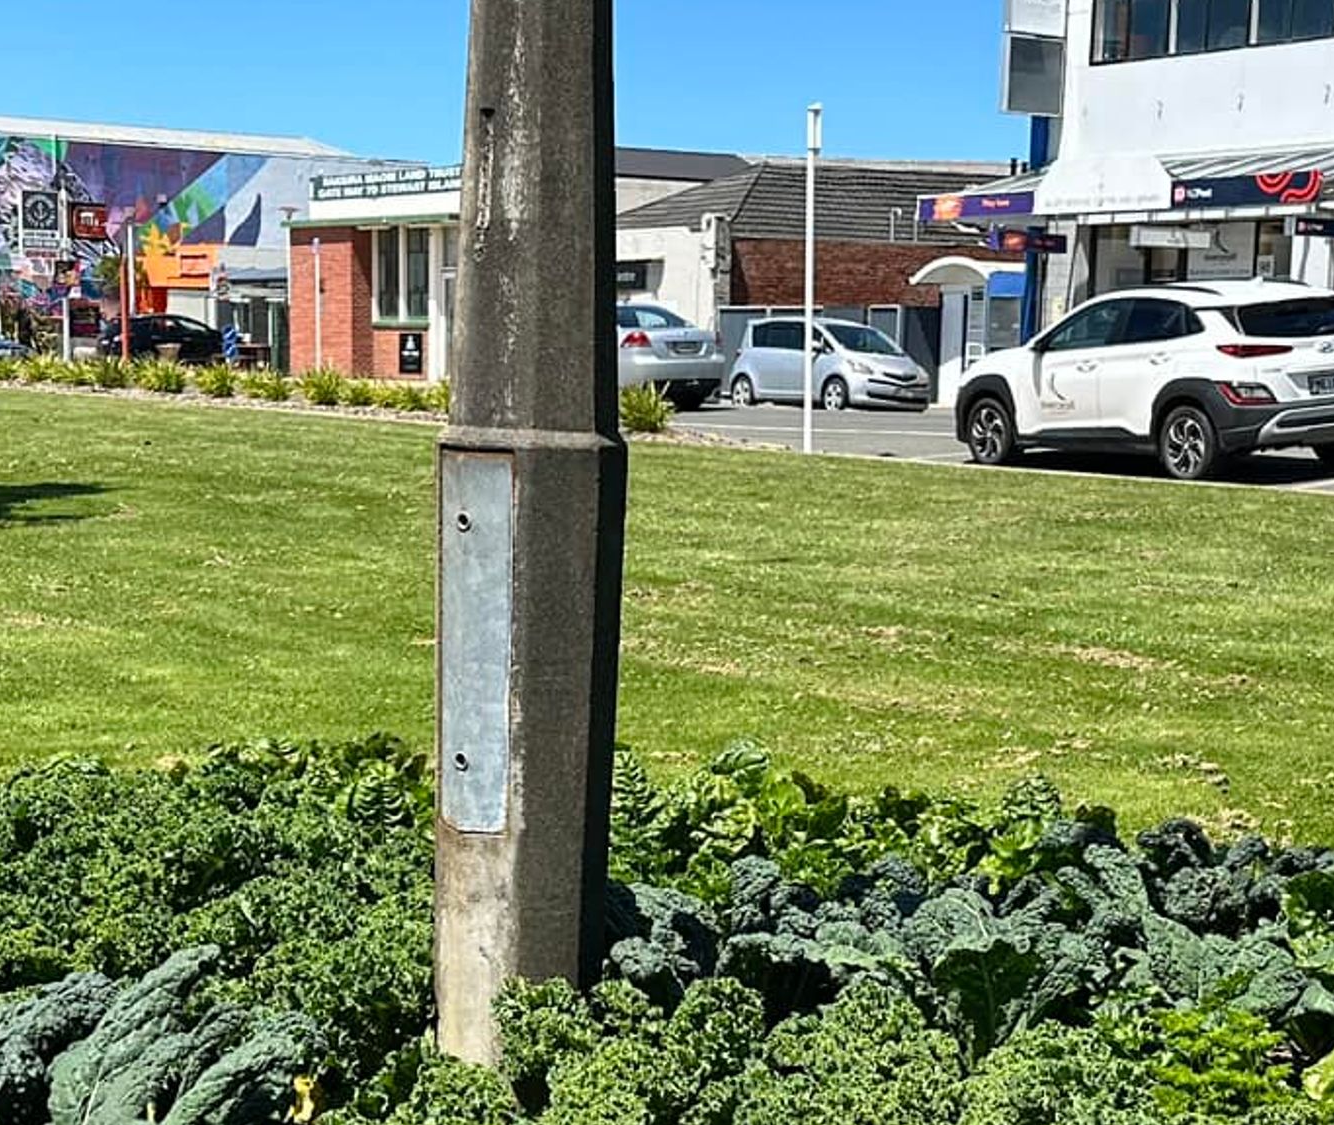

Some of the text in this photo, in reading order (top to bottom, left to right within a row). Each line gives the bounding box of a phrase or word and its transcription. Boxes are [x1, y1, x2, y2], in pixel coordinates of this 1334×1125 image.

[399, 169, 426, 180] LAND
[318, 188, 341, 199] GATE
[366, 185, 379, 195] TO
